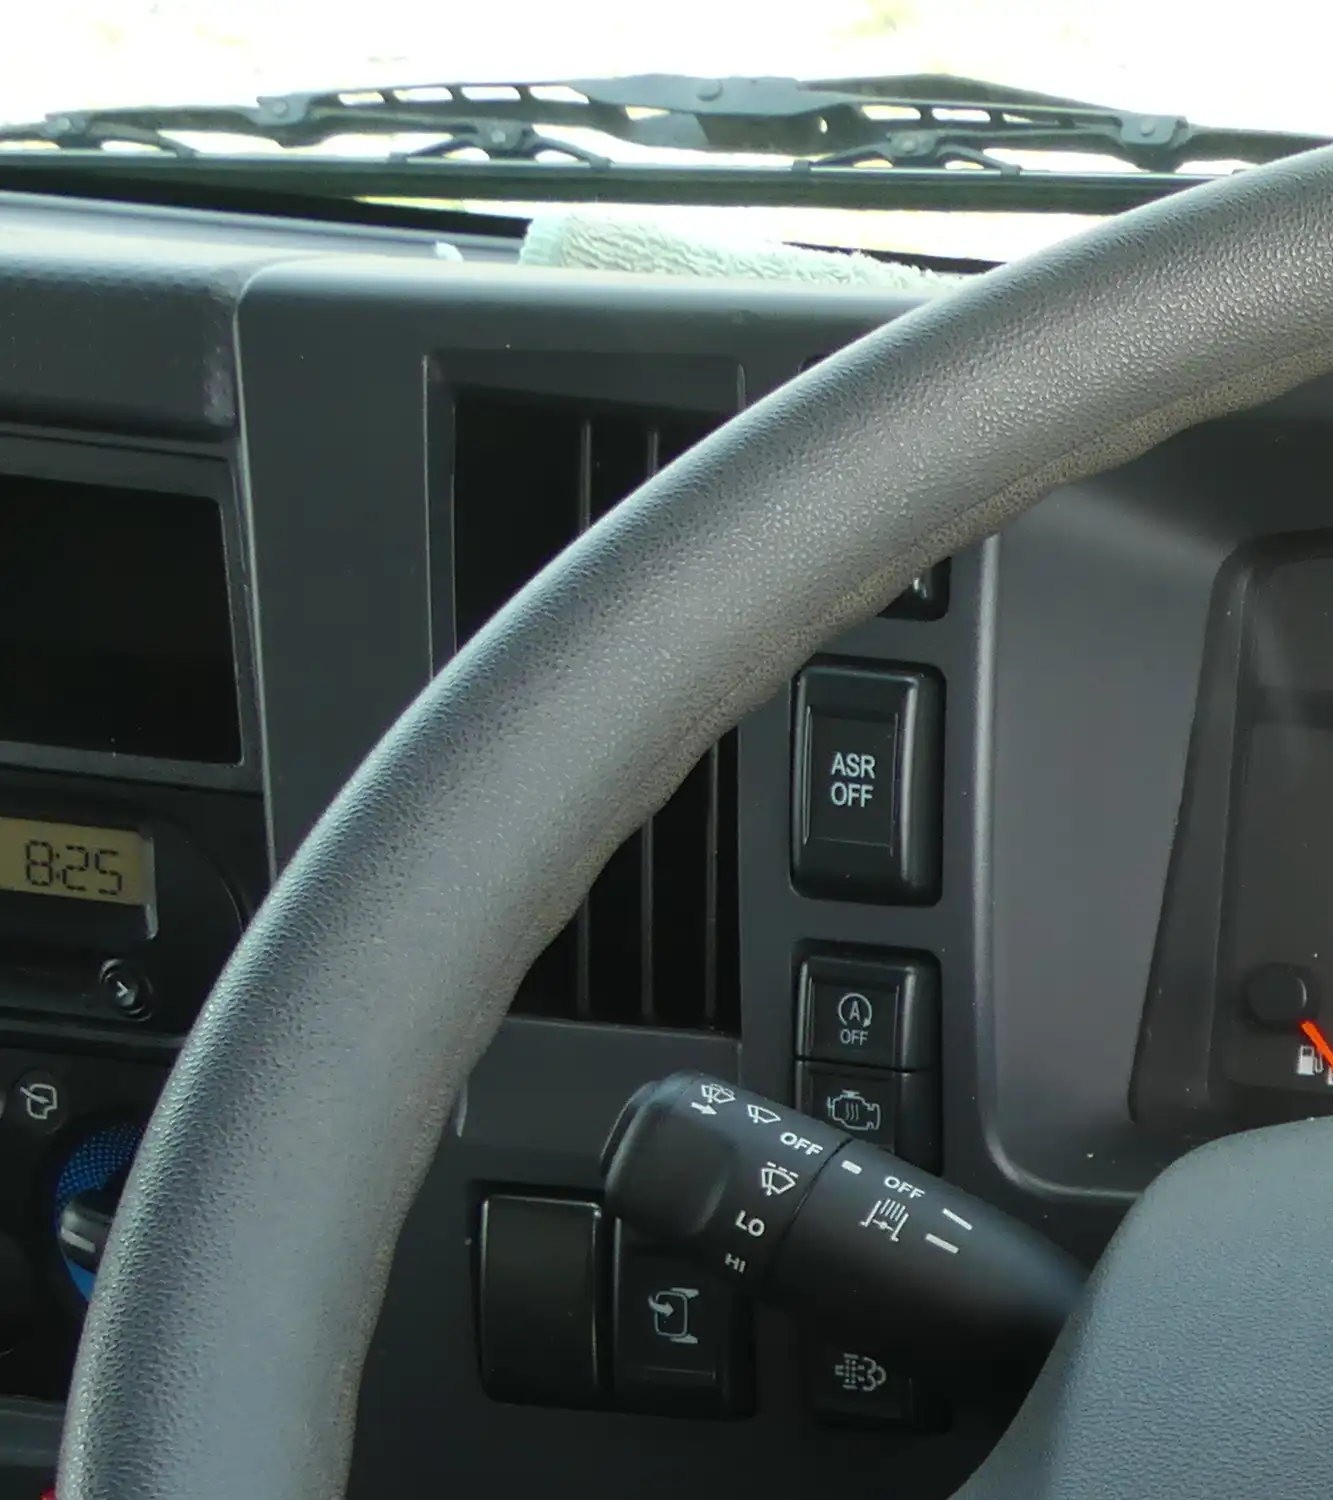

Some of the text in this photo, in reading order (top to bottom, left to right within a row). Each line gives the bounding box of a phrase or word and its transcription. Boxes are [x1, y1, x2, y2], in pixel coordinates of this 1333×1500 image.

[831, 752, 876, 779] ASR
[831, 782, 874, 807] OFF
[26, 839, 122, 895] 8:25
[841, 1028, 868, 1046] OFF
[780, 1132, 823, 1155] OFF
[884, 1176, 925, 1199] OFF
[735, 1209, 766, 1237] LO
[724, 1253, 747, 1274] HI
